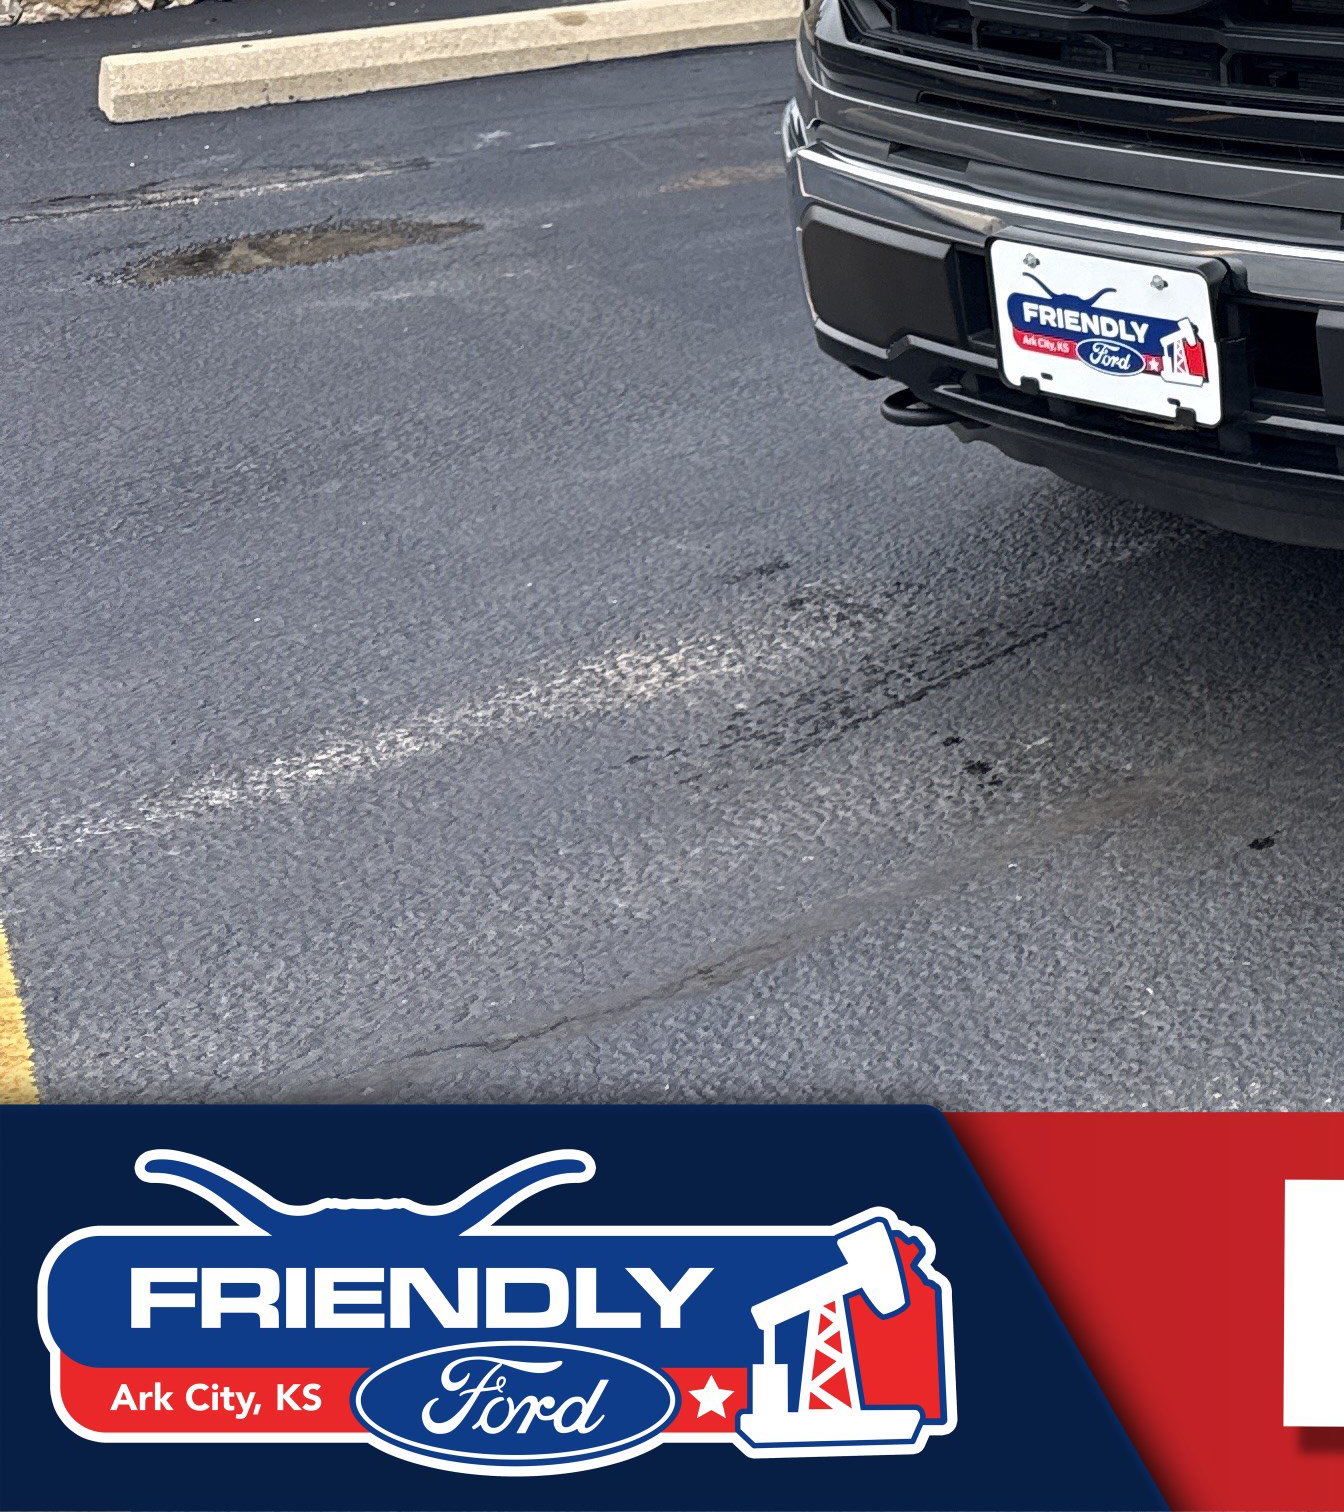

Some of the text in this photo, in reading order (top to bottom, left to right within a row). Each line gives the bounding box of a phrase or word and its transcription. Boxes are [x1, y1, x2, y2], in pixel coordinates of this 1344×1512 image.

[1022, 301, 1149, 344] FRIENDLY
[1057, 342, 1070, 354] KS
[1089, 342, 1131, 370] Ford
